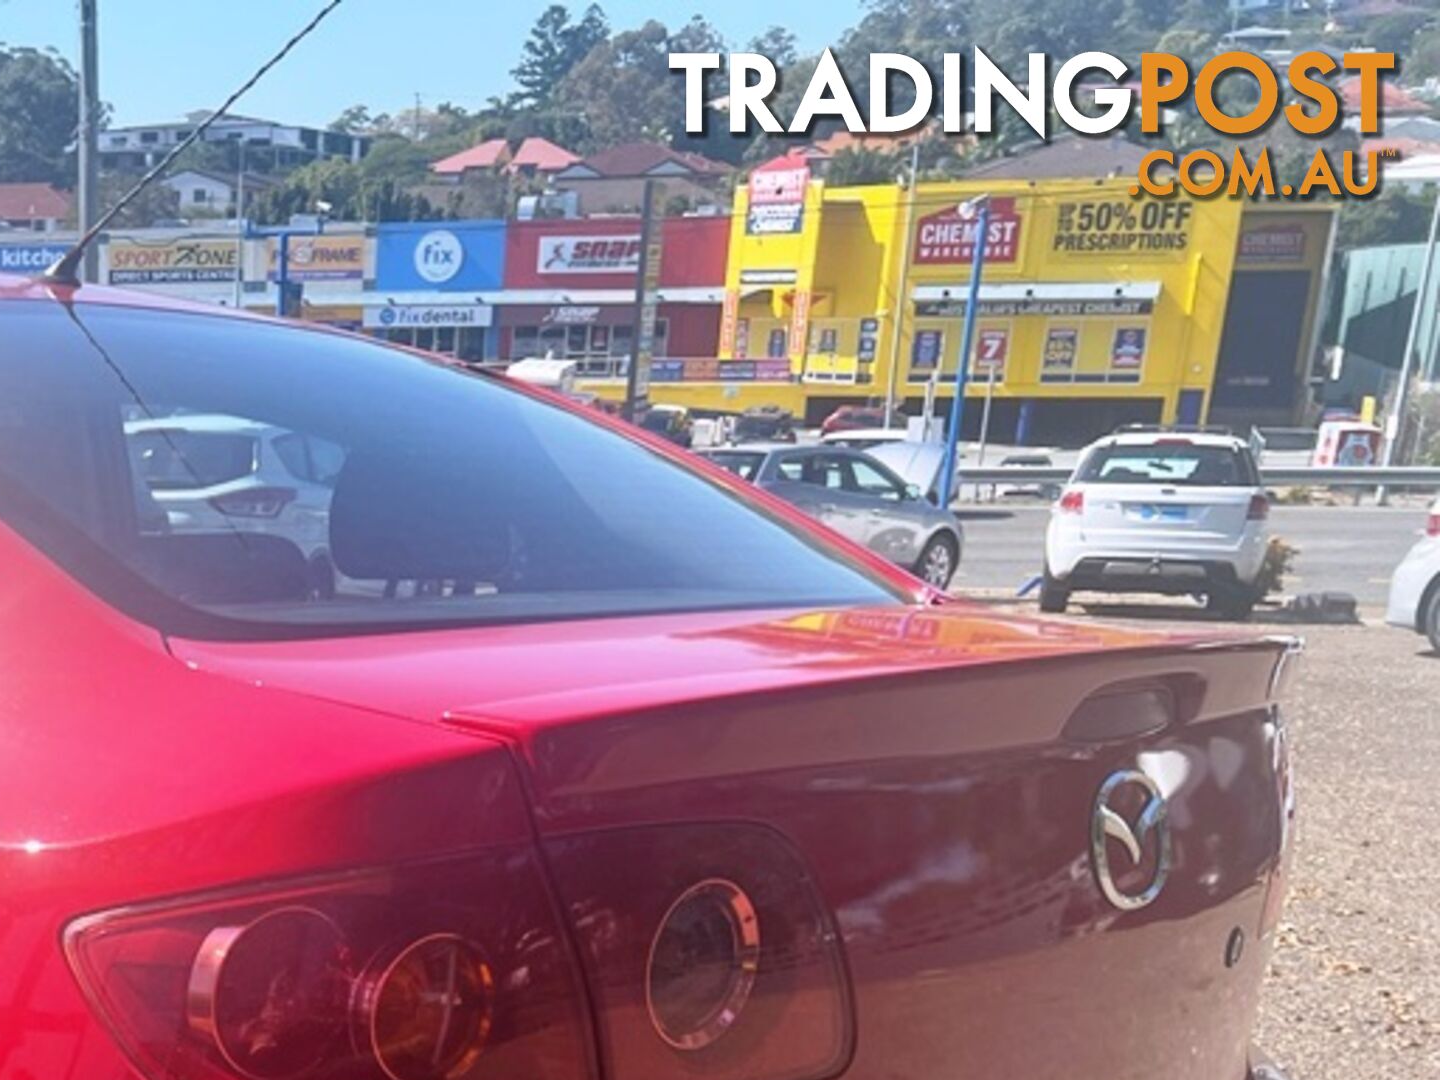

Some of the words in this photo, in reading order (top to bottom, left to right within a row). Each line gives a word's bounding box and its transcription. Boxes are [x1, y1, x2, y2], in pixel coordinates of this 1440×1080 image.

[1077, 202, 1136, 231] 50%
[1141, 202, 1193, 231] OFF
[921, 221, 1016, 244] CHEMST
[1053, 233, 1188, 251] PRESCRIPTIONS
[423, 241, 454, 265] fix
[920, 245, 1011, 257] WAREHUSE
